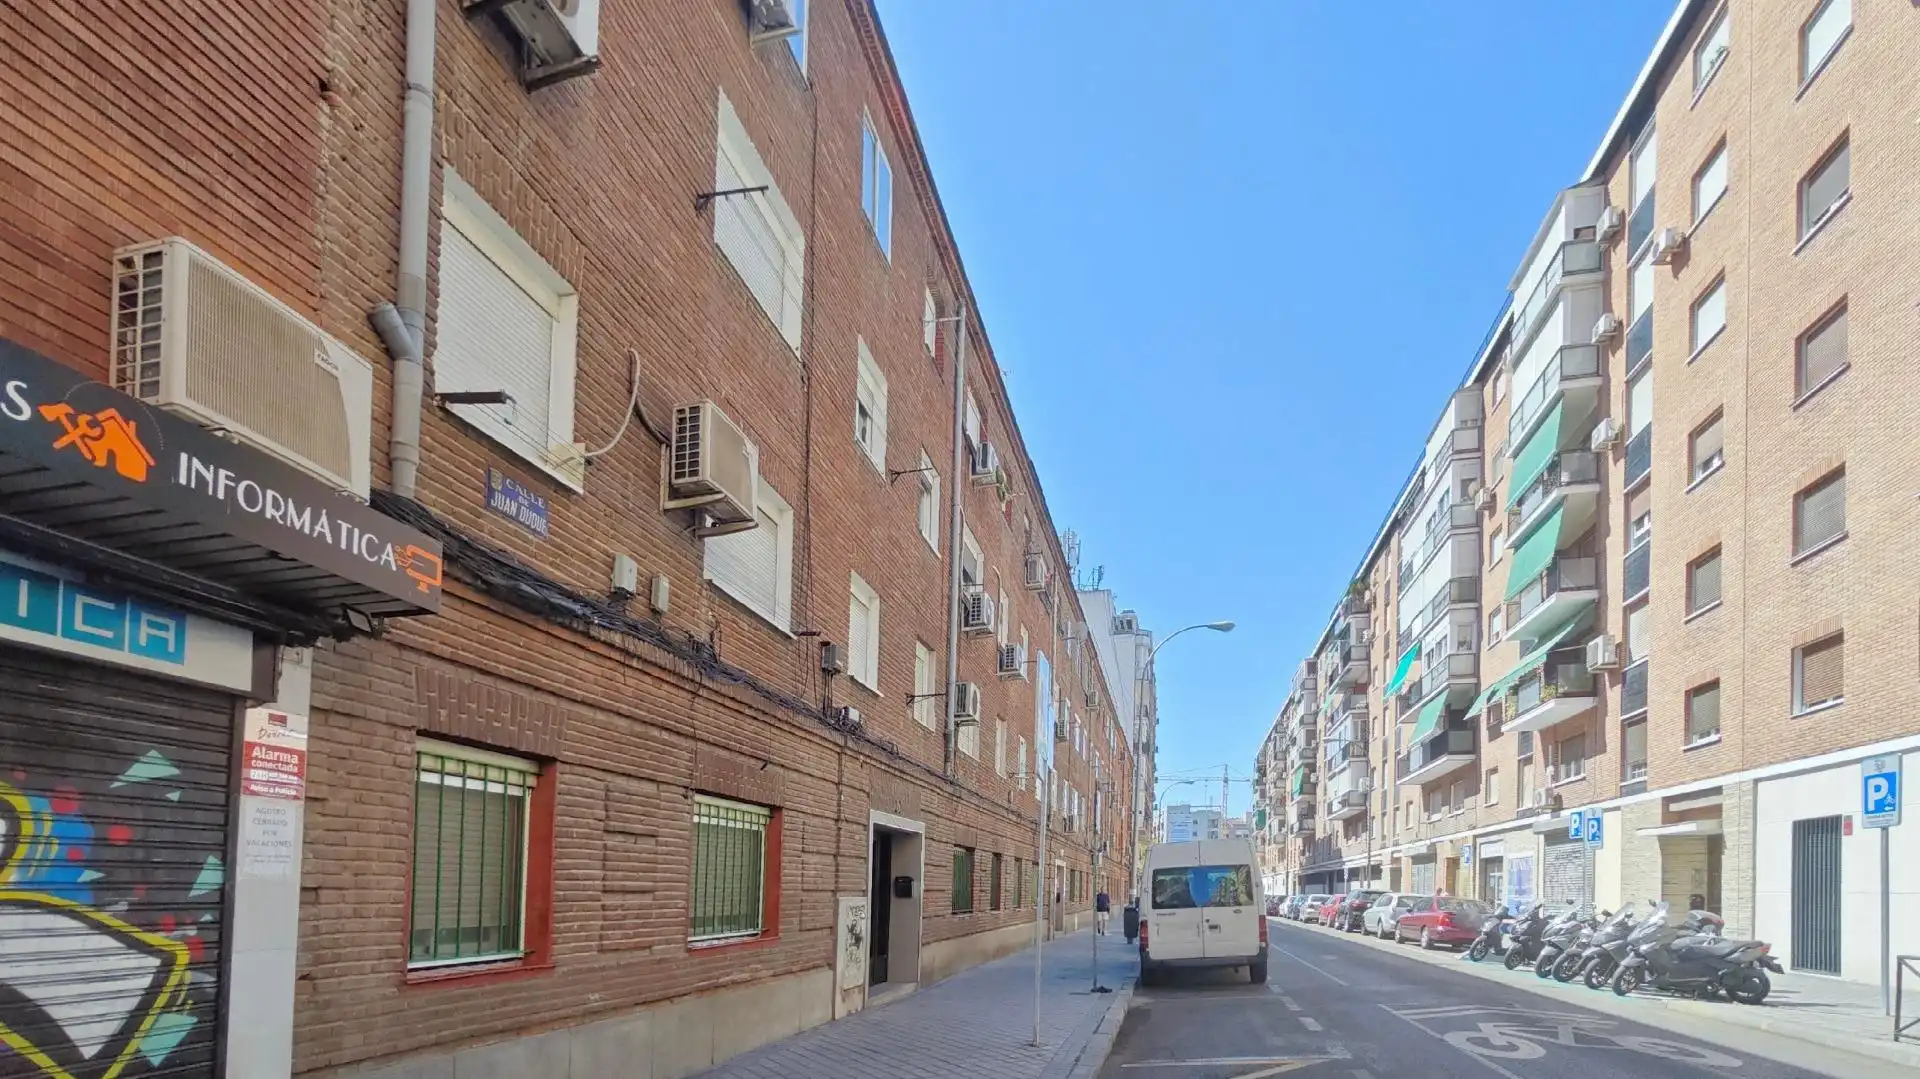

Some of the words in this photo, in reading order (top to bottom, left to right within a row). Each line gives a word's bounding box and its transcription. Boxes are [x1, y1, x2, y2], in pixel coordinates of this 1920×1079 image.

[506, 479, 545, 508] CALLE
[519, 495, 529, 507] DE
[178, 452, 397, 571] INFORMÁTICA
[491, 491, 518, 516] JUAN
[519, 507, 547, 535] DUQUE
[252, 746, 298, 764] Alarma
[251, 760, 298, 772] conectada
[1868, 777, 1889, 812] P
[255, 807, 286, 815] AGOSTO
[252, 818, 288, 827] CERRADO
[1571, 812, 1580, 836] P
[1588, 820, 1598, 840] P
[246, 839, 293, 847] VACACIONES
